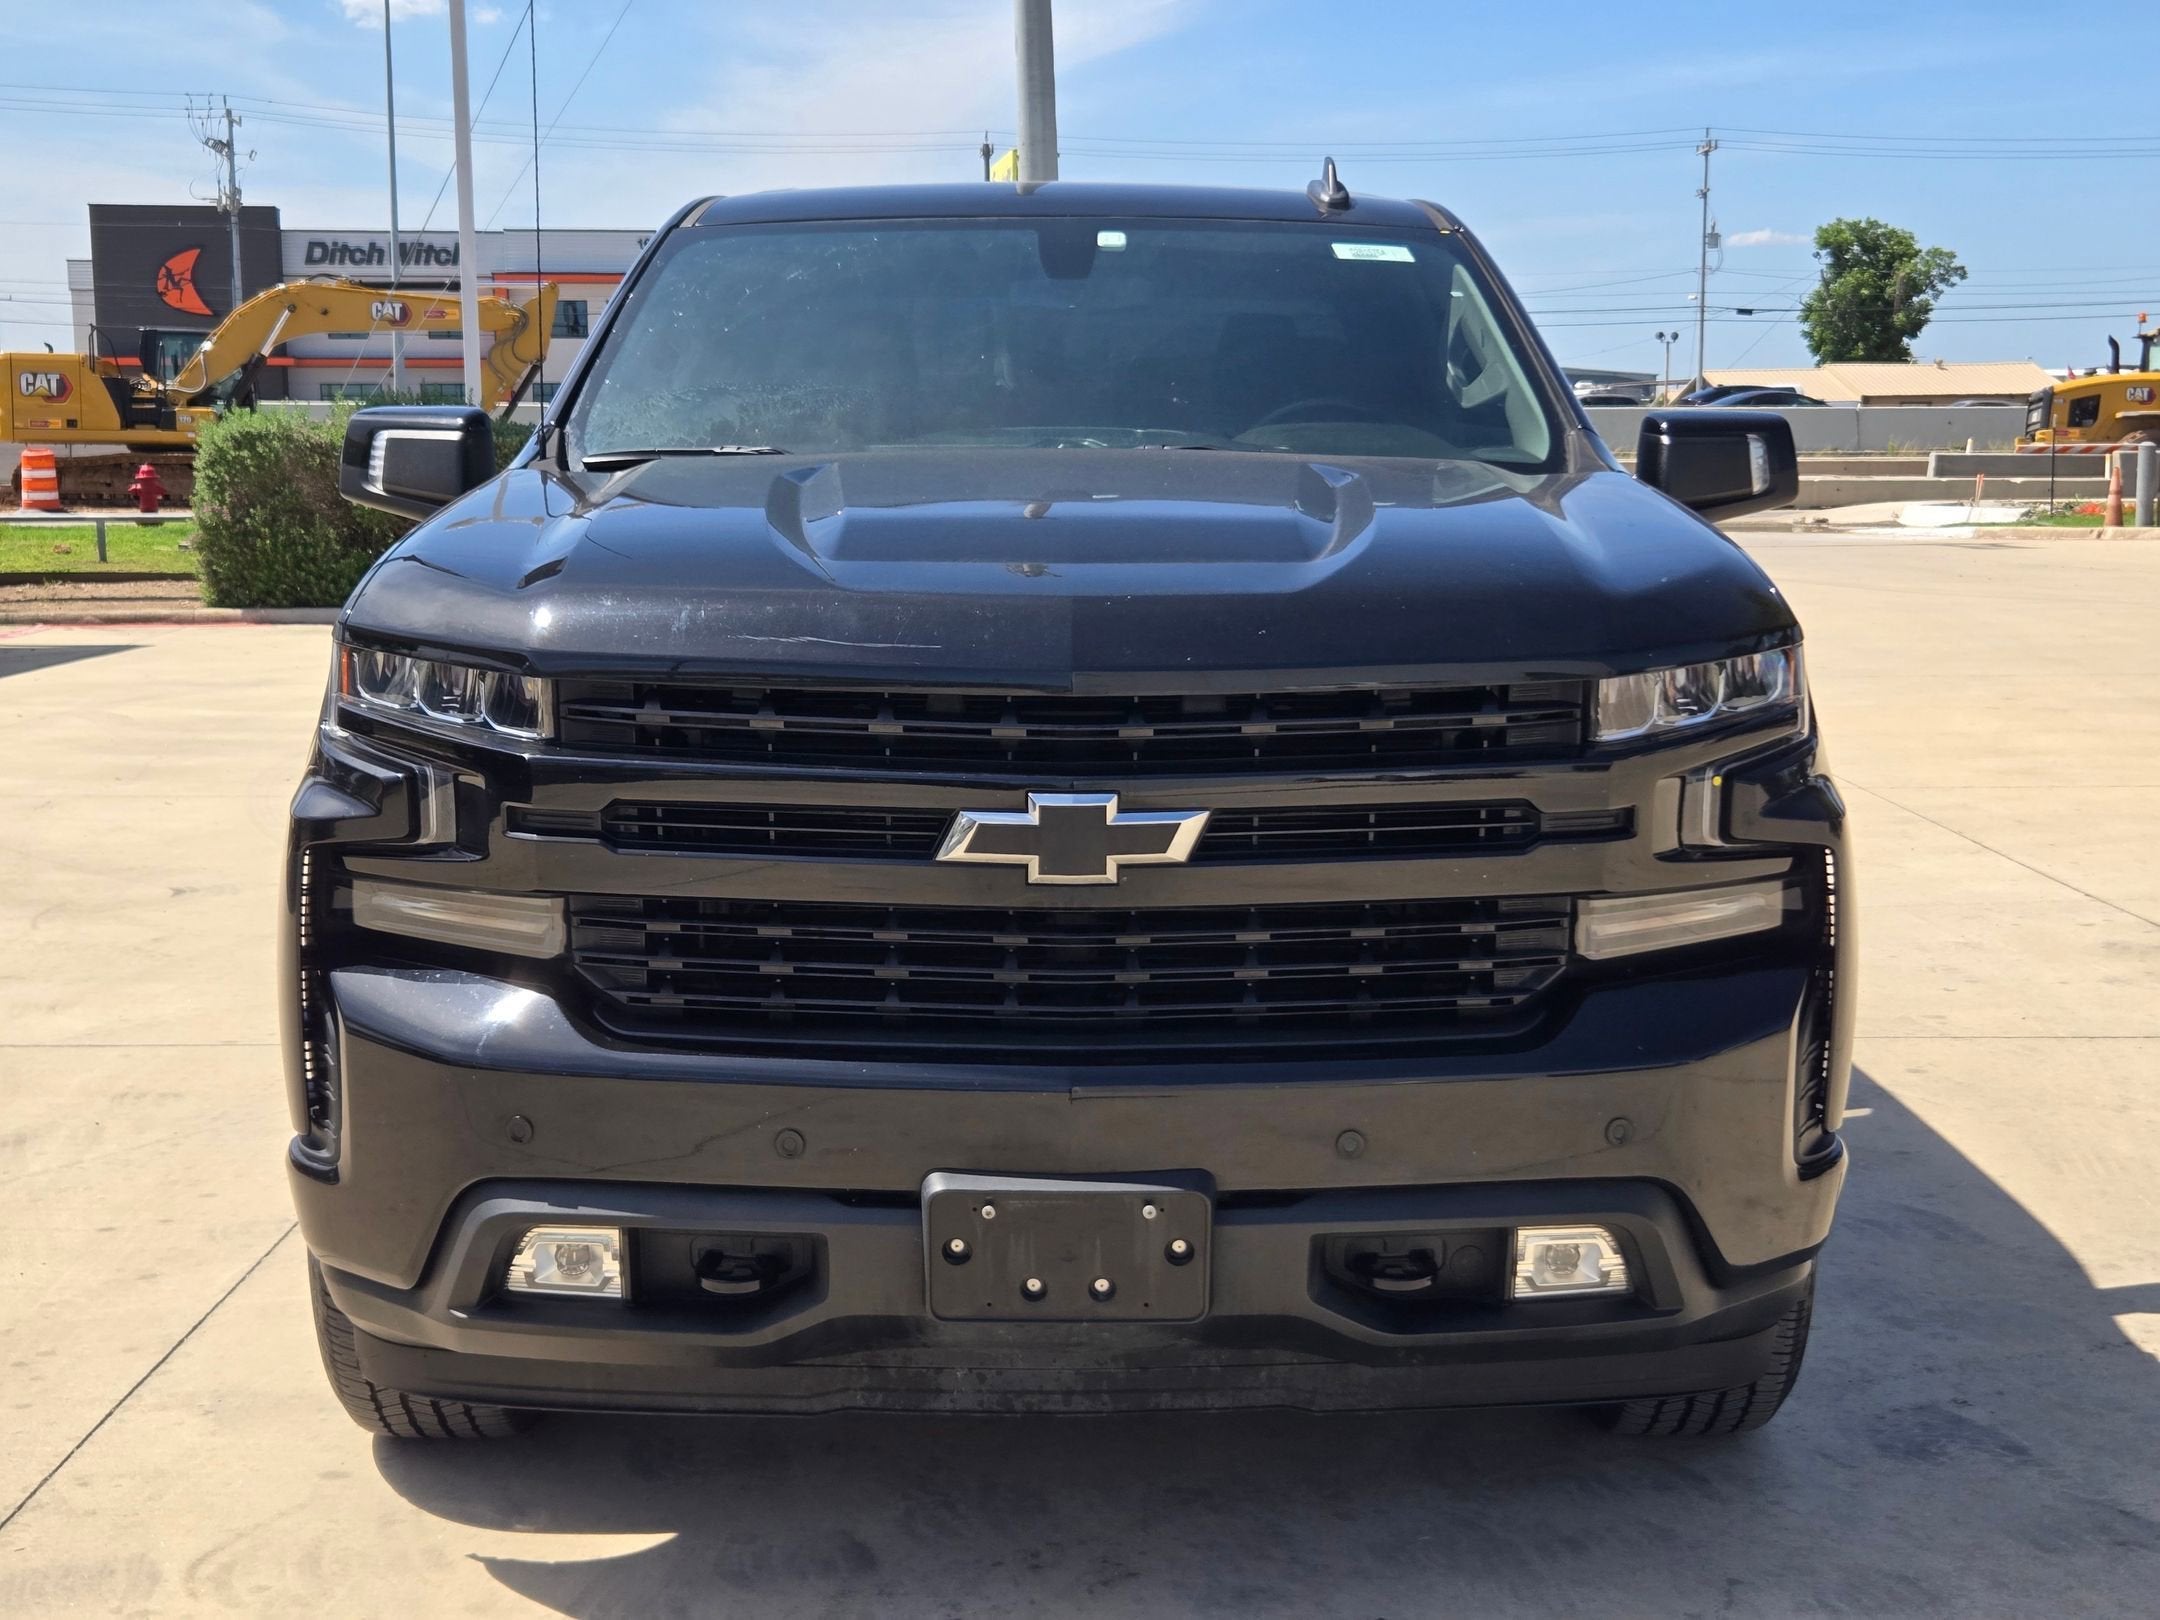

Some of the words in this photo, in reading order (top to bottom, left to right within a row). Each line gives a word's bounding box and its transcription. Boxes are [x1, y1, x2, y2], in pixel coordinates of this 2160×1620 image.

[304, 241, 384, 265] Ditch
[371, 302, 403, 322] CAT
[20, 373, 60, 397] CAT
[2127, 387, 2150, 401] CAT
